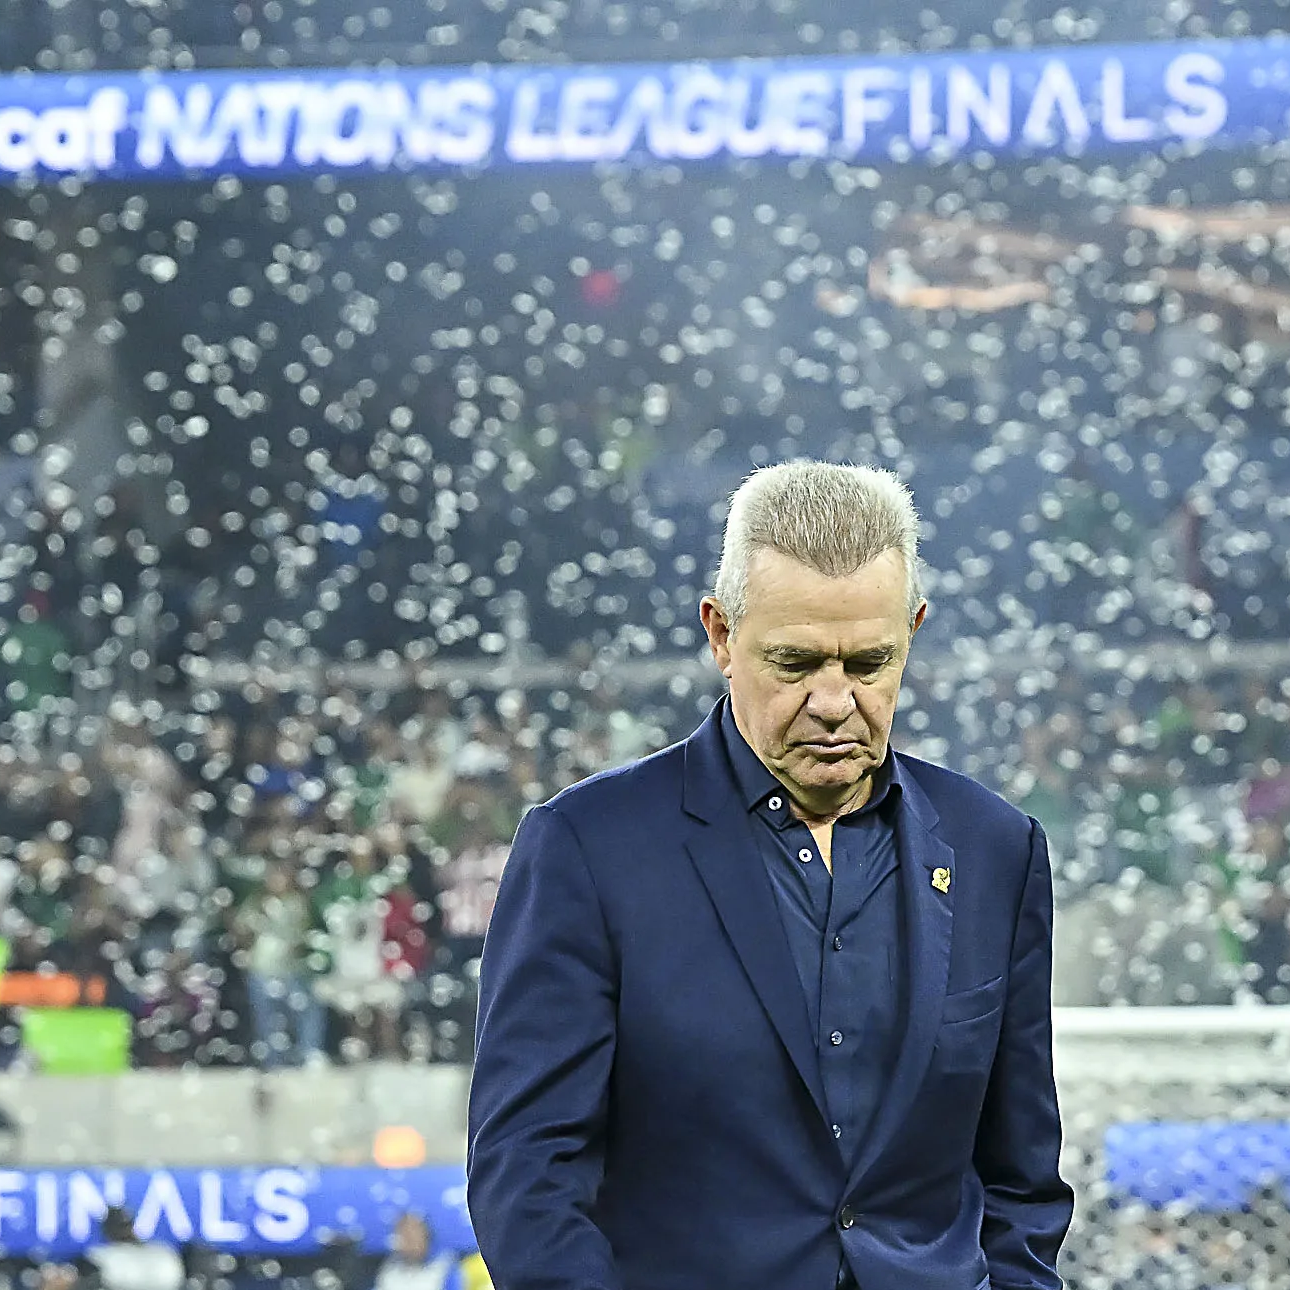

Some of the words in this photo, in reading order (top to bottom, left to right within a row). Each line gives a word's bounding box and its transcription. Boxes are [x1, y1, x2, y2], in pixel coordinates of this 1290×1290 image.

[137, 80, 496, 170] NATIONS
[505, 72, 827, 163] LEAGUE
[841, 53, 1229, 152] FINALS
